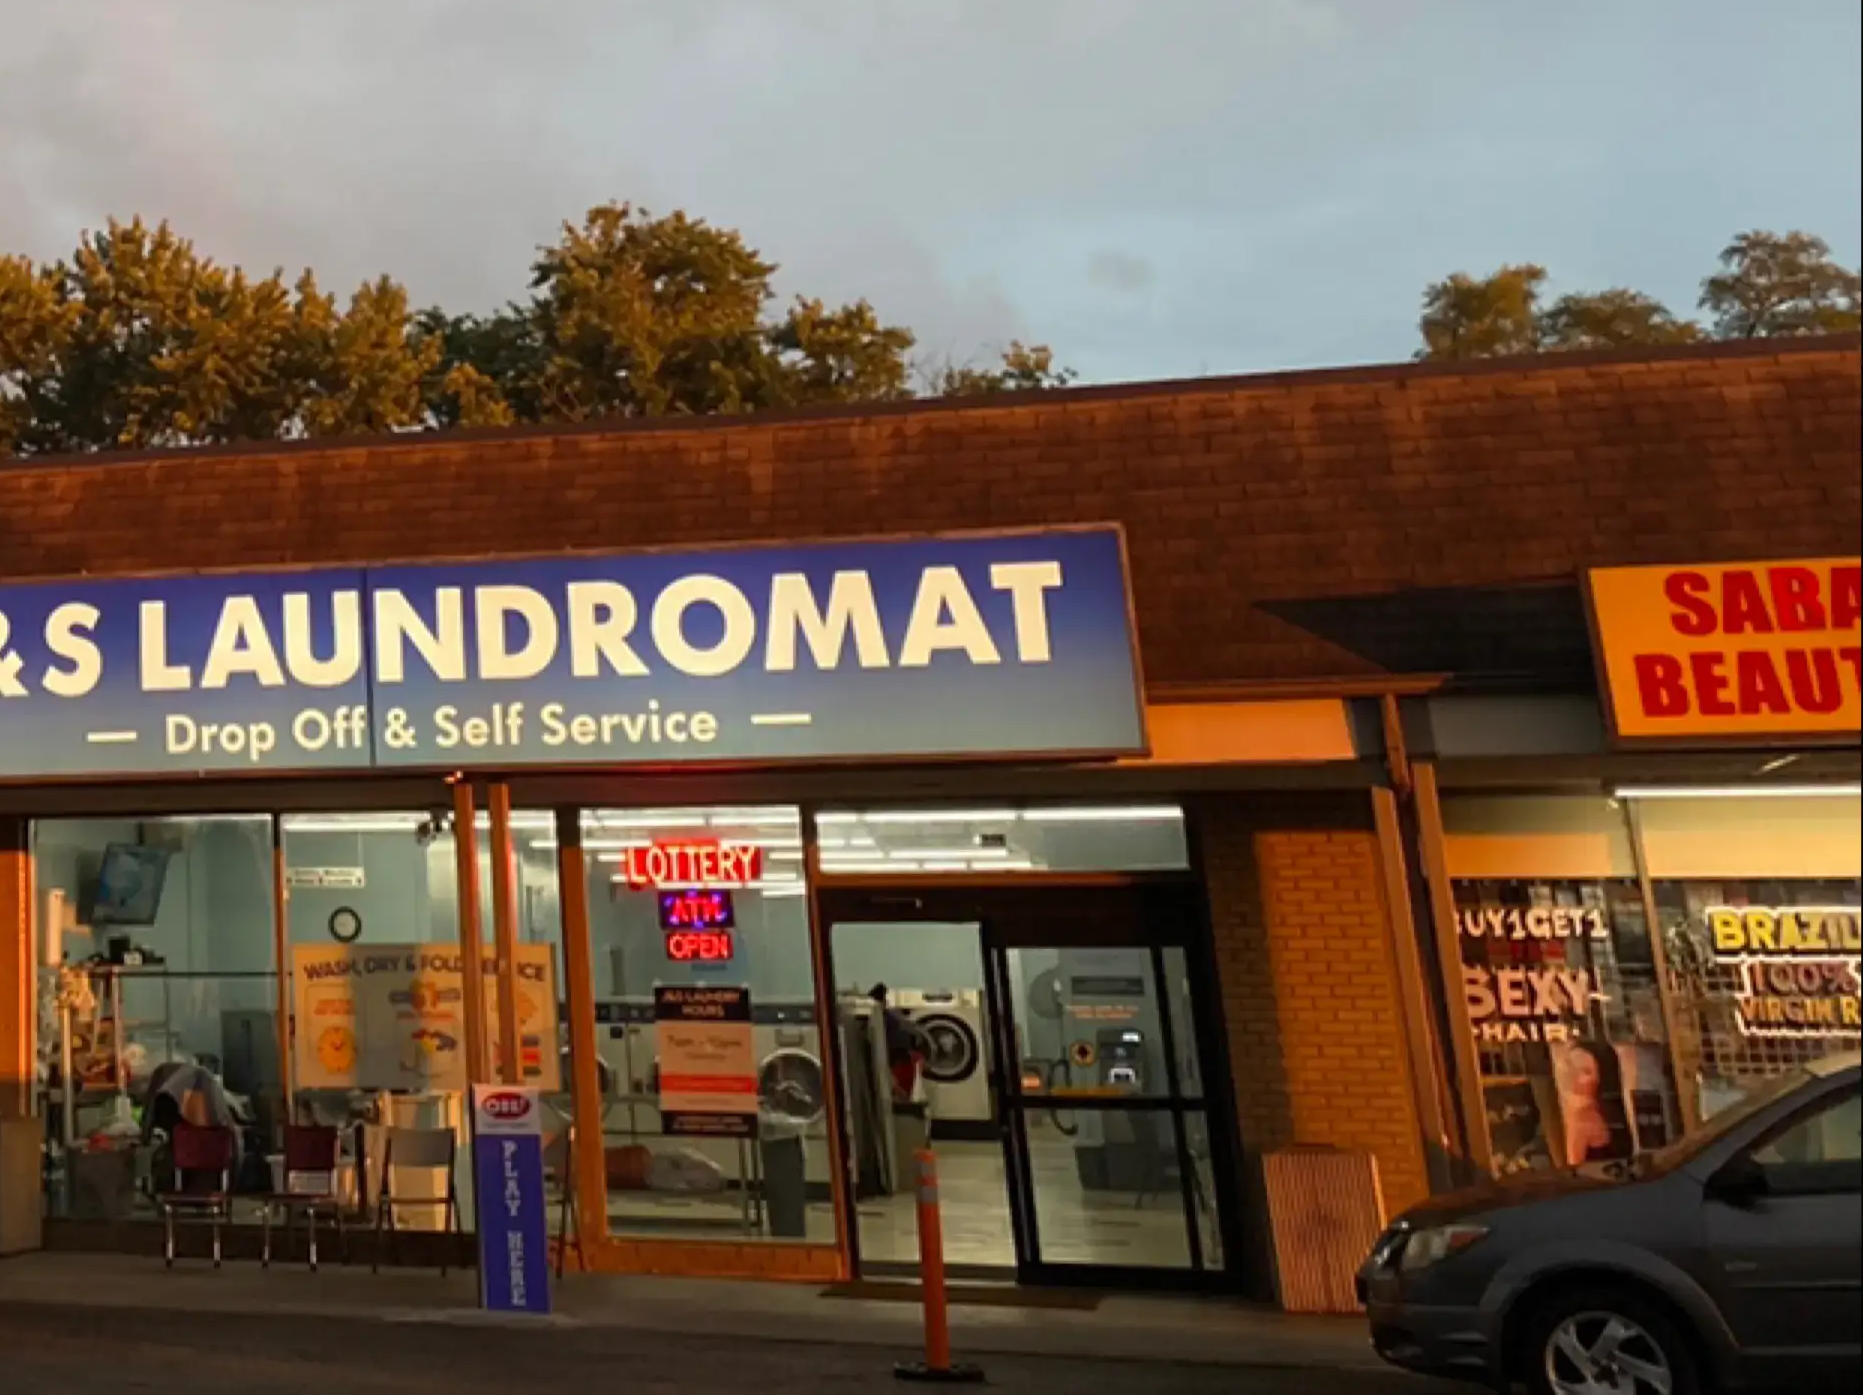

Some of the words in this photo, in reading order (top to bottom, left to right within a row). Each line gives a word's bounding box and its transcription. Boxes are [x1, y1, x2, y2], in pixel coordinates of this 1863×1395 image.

[140, 560, 1062, 692] LAUNDROMAT
[165, 713, 276, 762] Drop
[292, 706, 370, 751] Off
[384, 706, 418, 748] &
[433, 703, 524, 747] Self
[539, 699, 720, 744] Service
[627, 845, 755, 883] LOTTERY
[363, 955, 401, 973] DRY
[405, 955, 416, 971] &
[669, 933, 729, 959] OPEN
[1742, 996, 1833, 1023] VIRGIN
[1481, 1022, 1568, 1042] HAIR
[502, 1140, 521, 1217] PLAY
[507, 1231, 527, 1307] HERE
